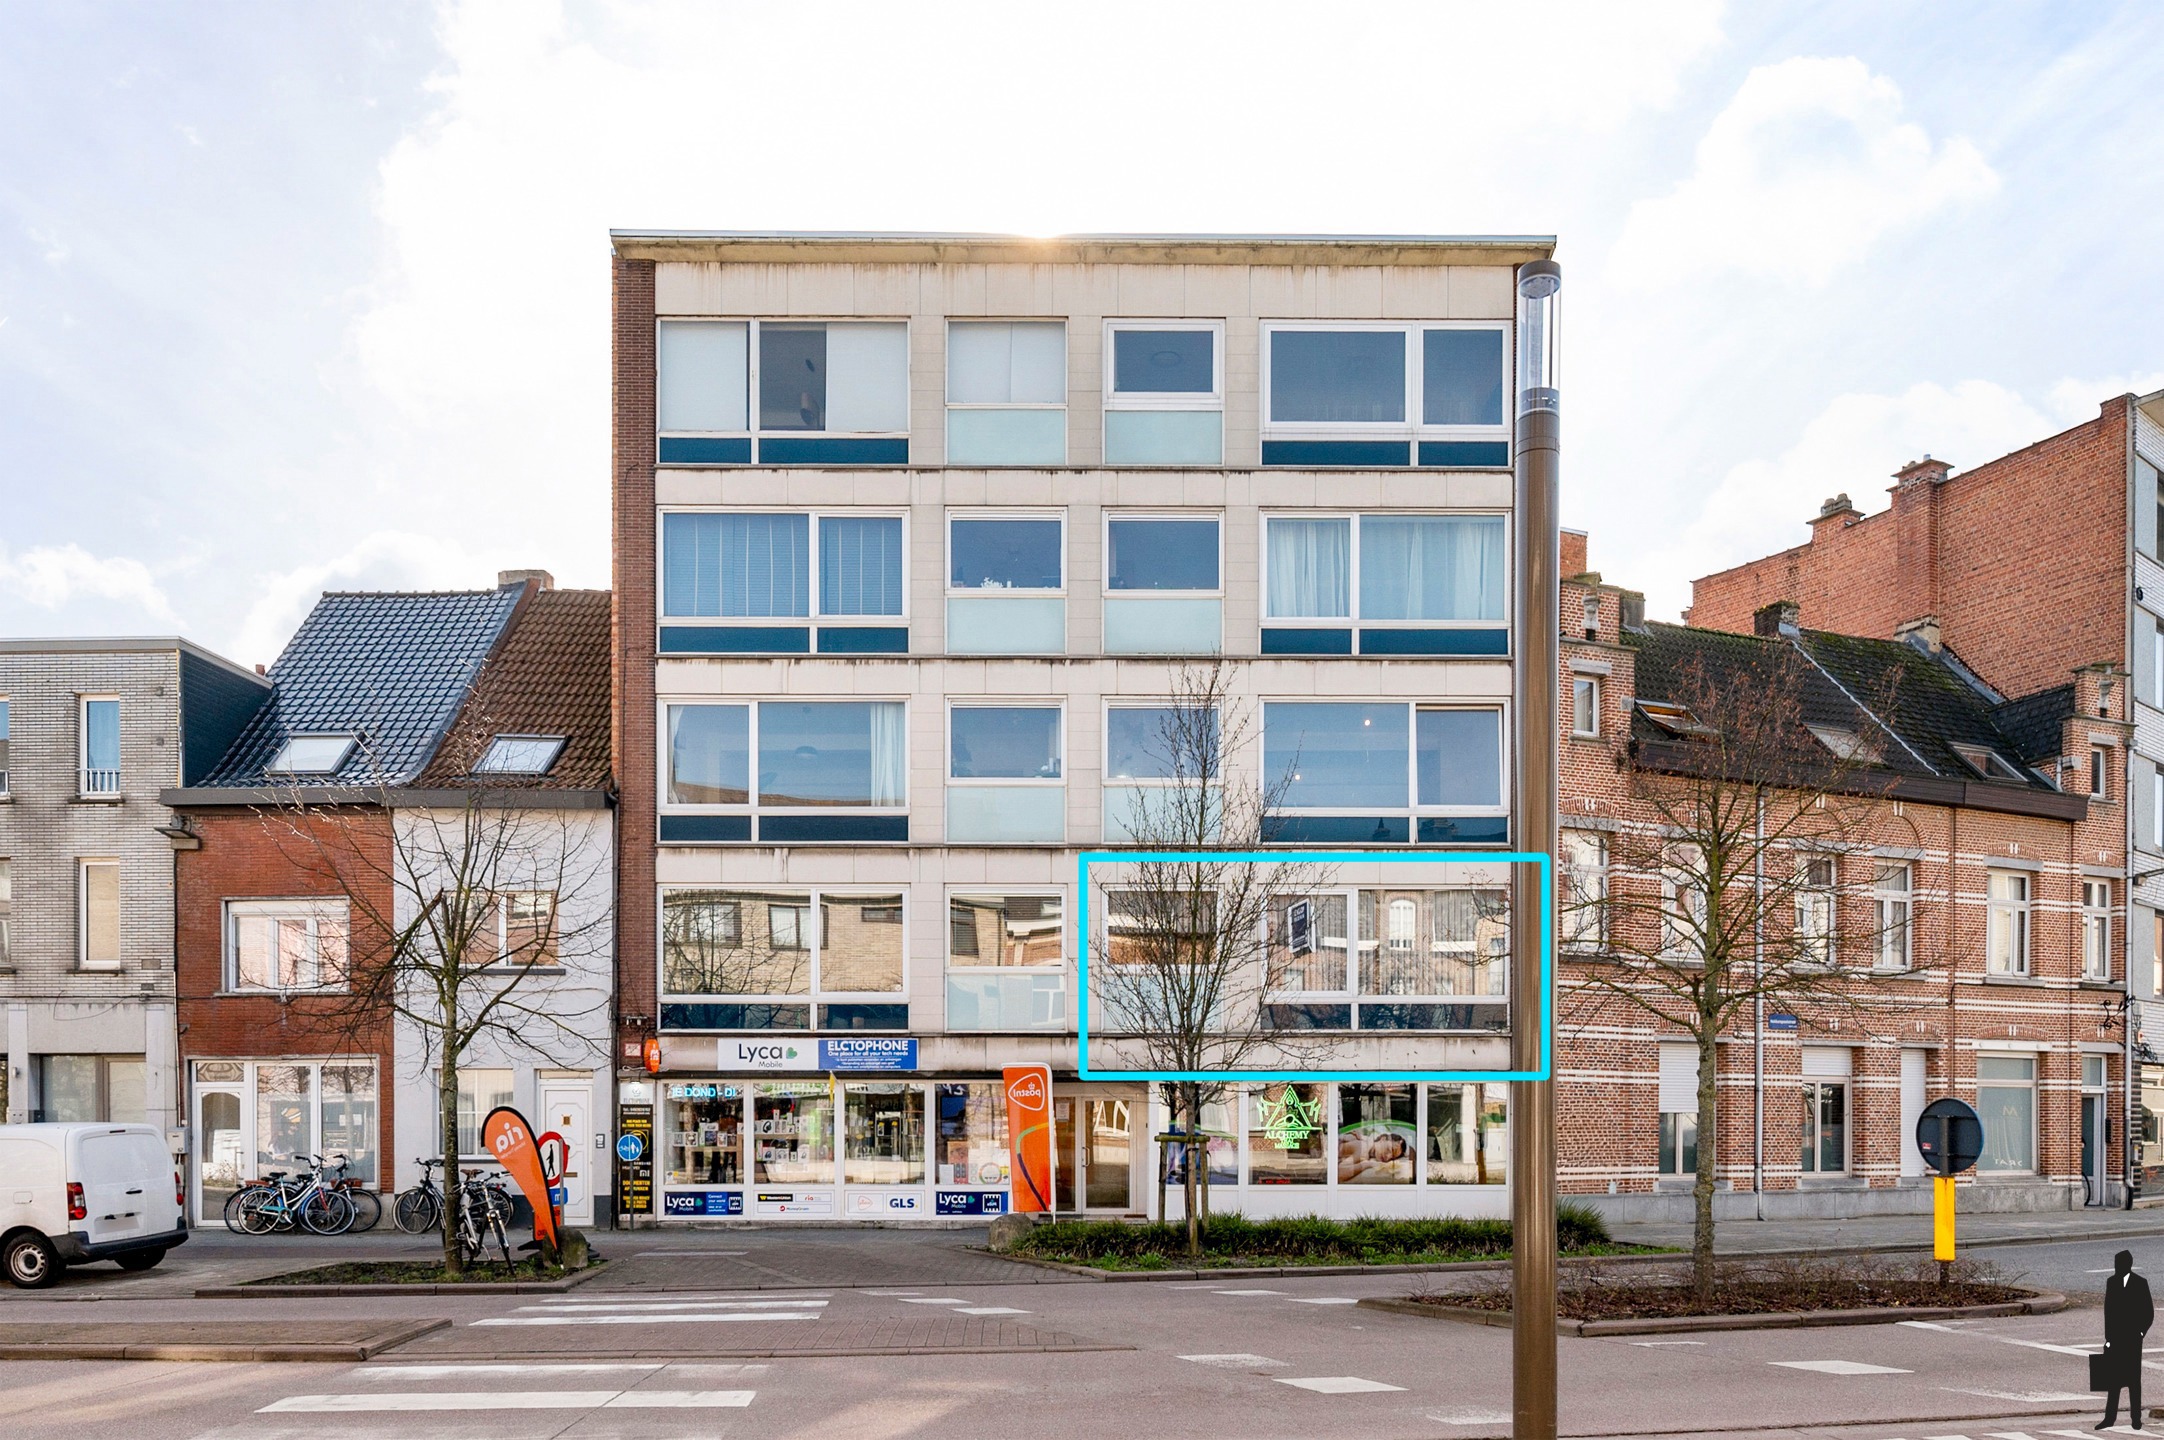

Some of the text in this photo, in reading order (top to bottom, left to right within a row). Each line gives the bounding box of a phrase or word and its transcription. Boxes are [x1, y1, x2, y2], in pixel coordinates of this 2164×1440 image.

[828, 1040, 908, 1051] ELCTOPHONE
[738, 1043, 782, 1063] Lyca
[684, 1087, 716, 1097] DOND
[1264, 1131, 1310, 1139] ALCHEMY
[667, 1196, 694, 1208] Lyca
[939, 1193, 966, 1205] Lyca
